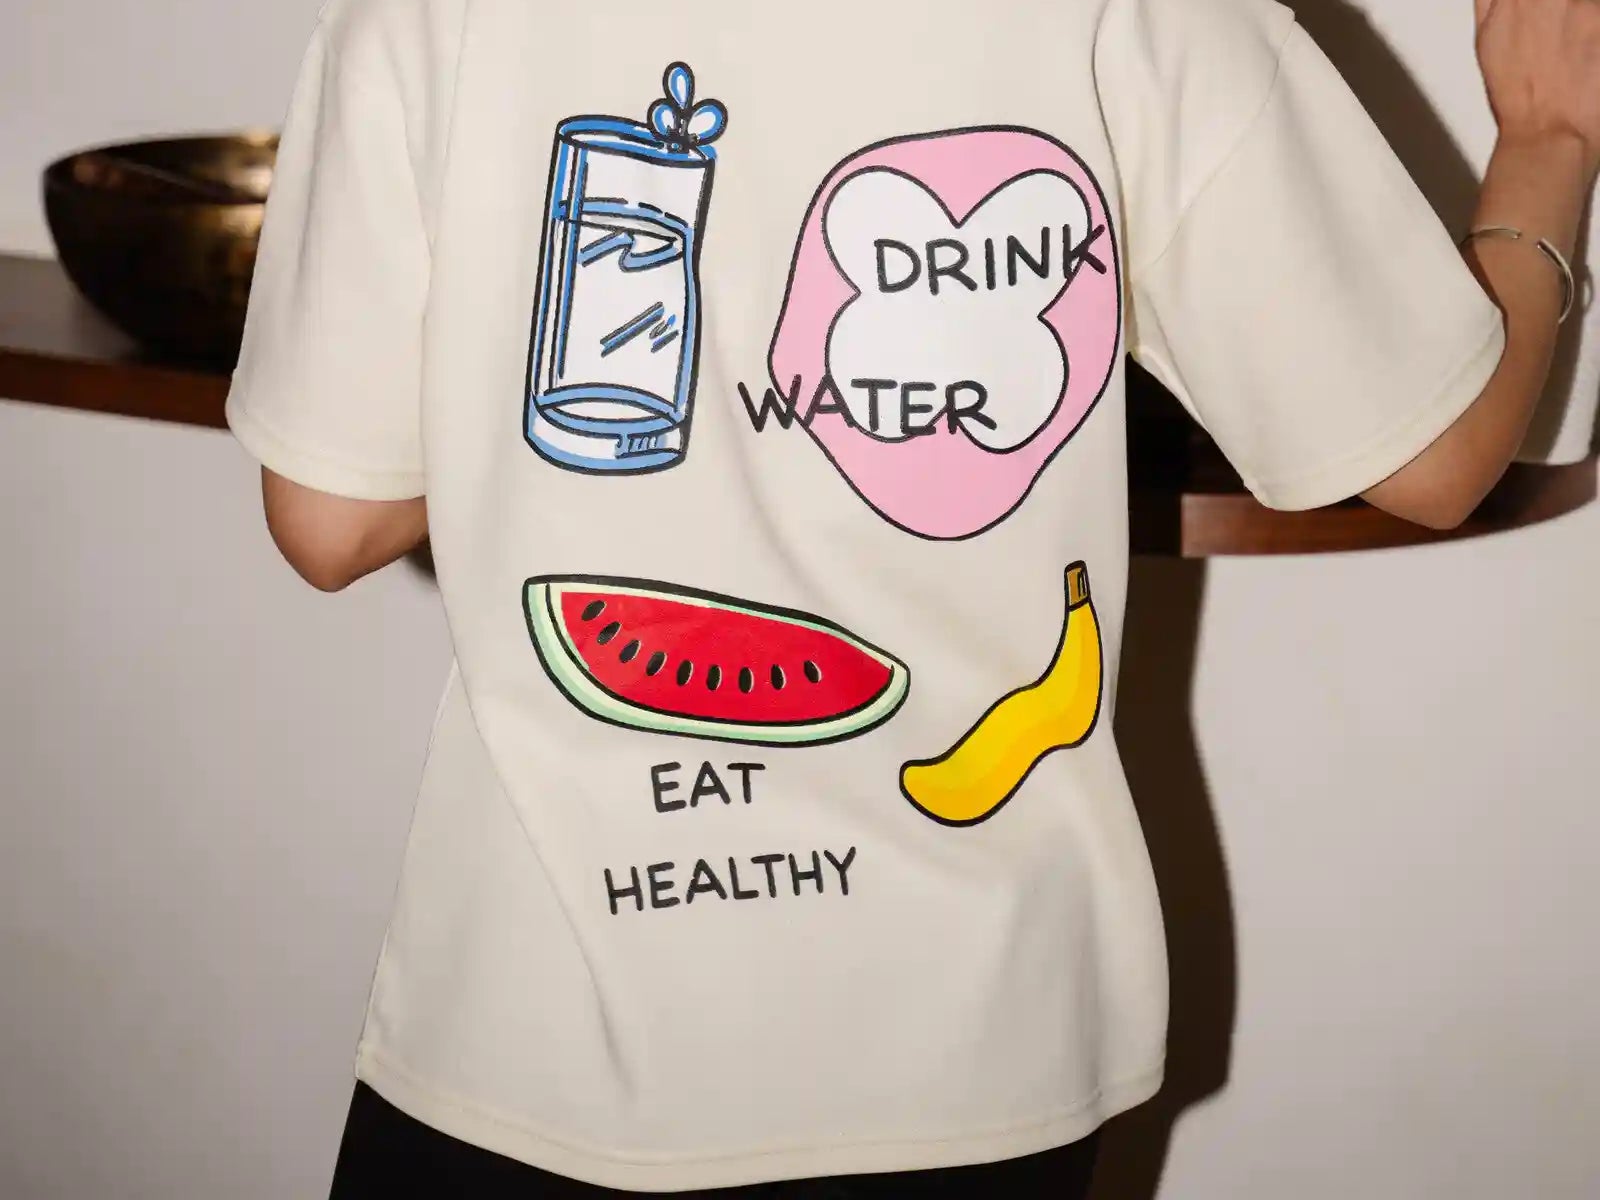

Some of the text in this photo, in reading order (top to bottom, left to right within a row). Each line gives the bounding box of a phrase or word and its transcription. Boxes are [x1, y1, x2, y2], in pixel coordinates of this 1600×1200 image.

[873, 223, 1107, 295] DRINK
[737, 374, 998, 435] WATER
[651, 761, 766, 813] EAT
[603, 846, 856, 915] HEALTHY
